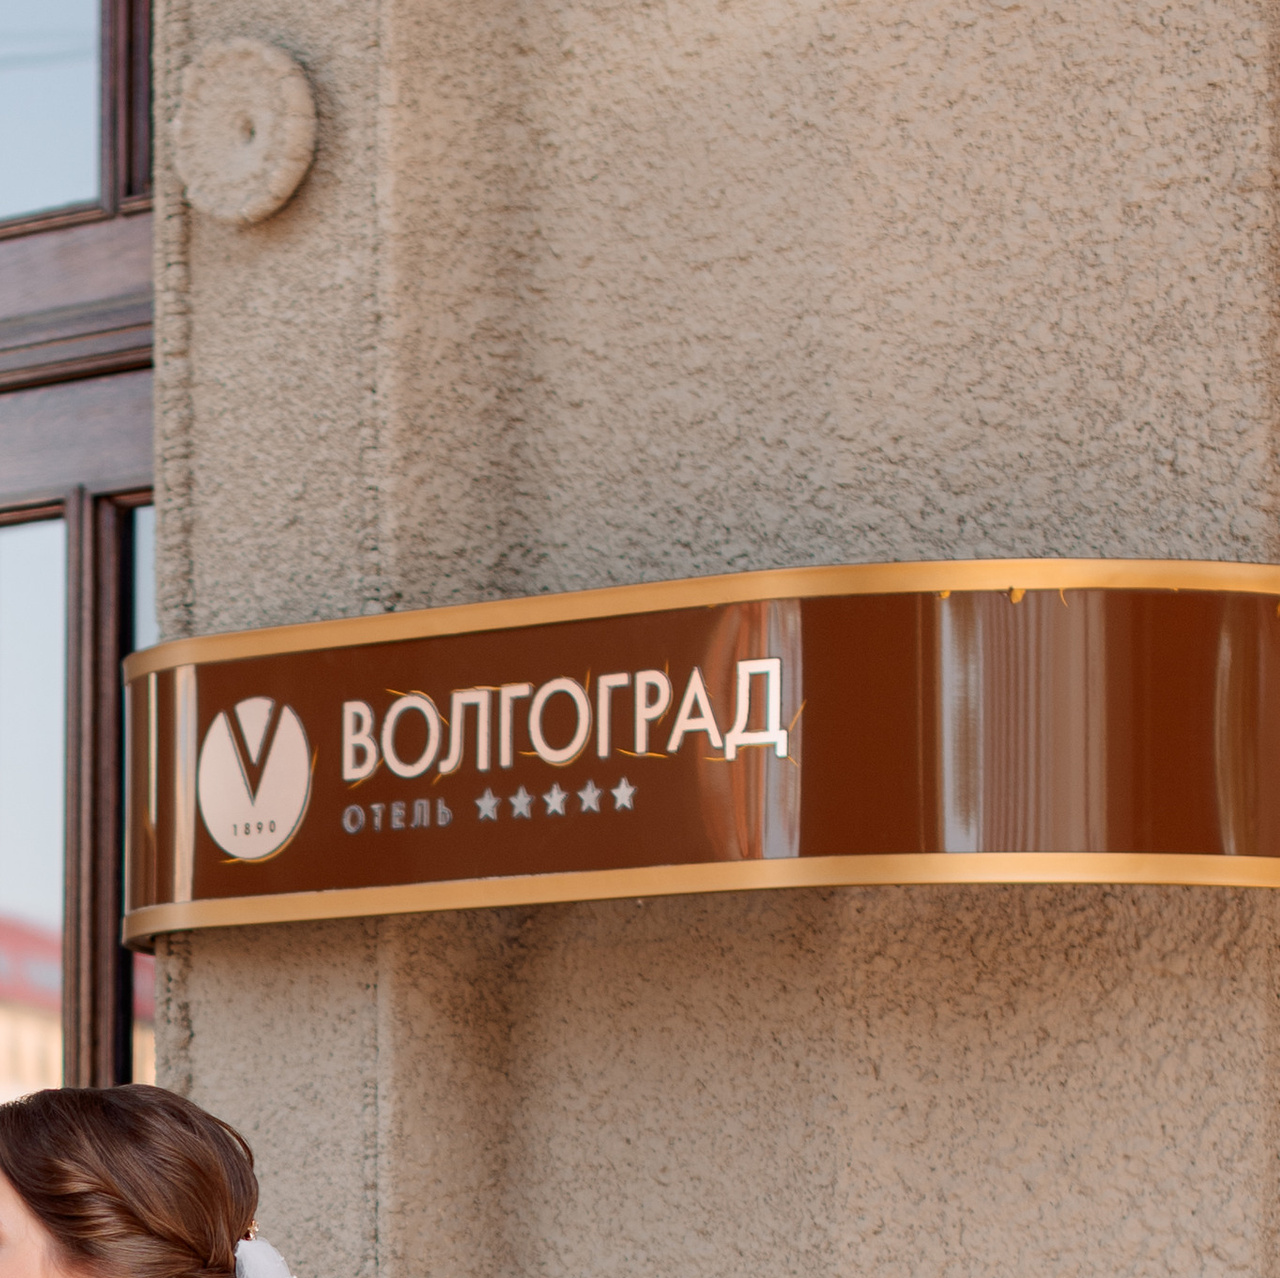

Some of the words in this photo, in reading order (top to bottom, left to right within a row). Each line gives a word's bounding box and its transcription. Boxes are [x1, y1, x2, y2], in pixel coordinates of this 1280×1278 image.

[342, 658, 788, 780] ВОЛГОГРАД
[231, 820, 277, 837] 1890
[342, 797, 453, 834] ОТЕЛЬ
